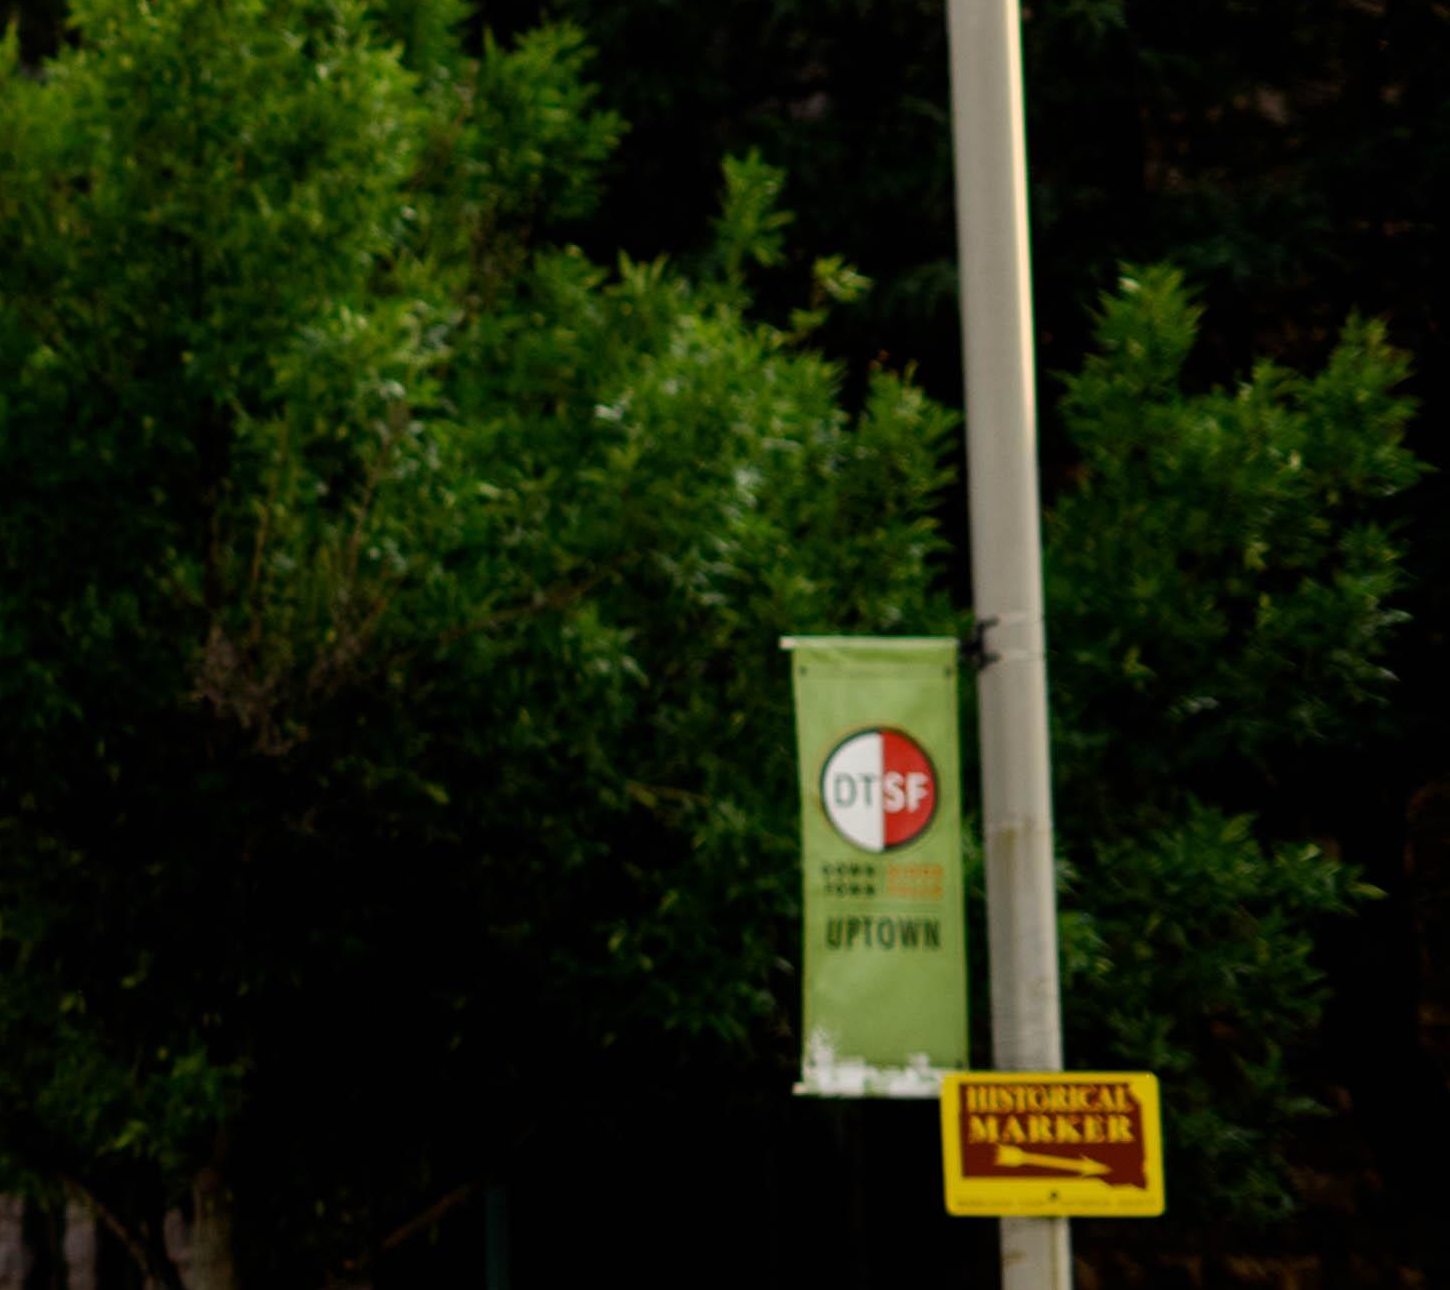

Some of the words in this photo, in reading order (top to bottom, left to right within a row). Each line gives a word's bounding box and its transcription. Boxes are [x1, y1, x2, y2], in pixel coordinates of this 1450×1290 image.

[833, 772, 930, 813] DTSF
[825, 915, 942, 951] UPTOWN
[965, 1084, 1134, 1113] HISTORICAL
[968, 1113, 1136, 1144] MARKER
